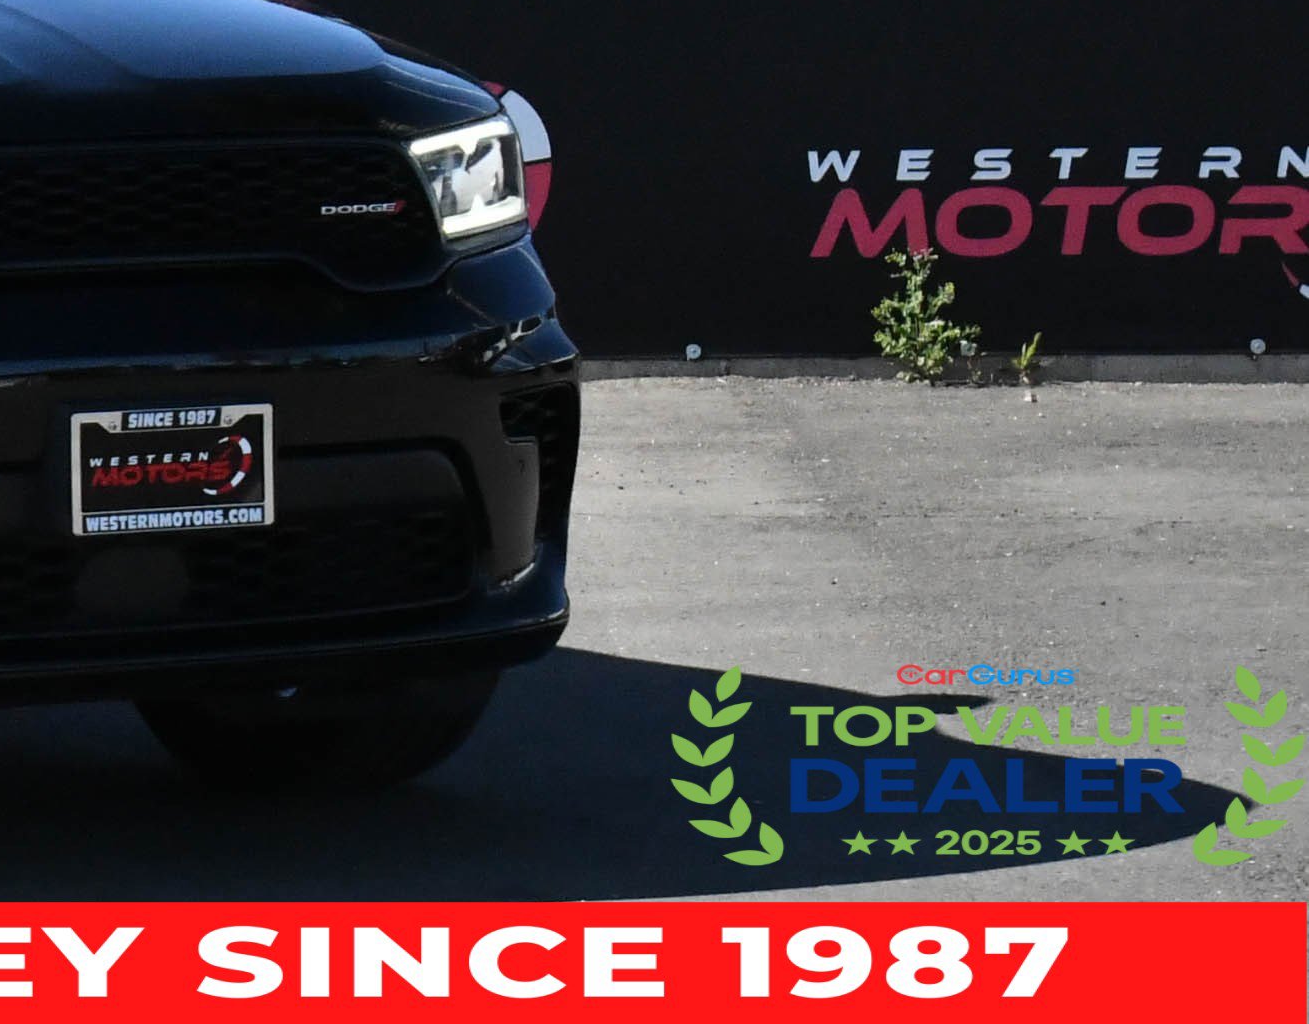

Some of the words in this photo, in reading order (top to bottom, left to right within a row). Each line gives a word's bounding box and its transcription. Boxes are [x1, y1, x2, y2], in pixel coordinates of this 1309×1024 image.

[807, 146, 1307, 183] WESTERN
[320, 202, 396, 215] DODGE
[809, 184, 1307, 259] MOTOR
[128, 411, 173, 429] SINCE
[179, 409, 216, 426] 1987
[89, 451, 209, 467] WESTERN
[91, 460, 231, 488] MOTORS
[86, 507, 263, 532] WESTERNMOTORS.COM
